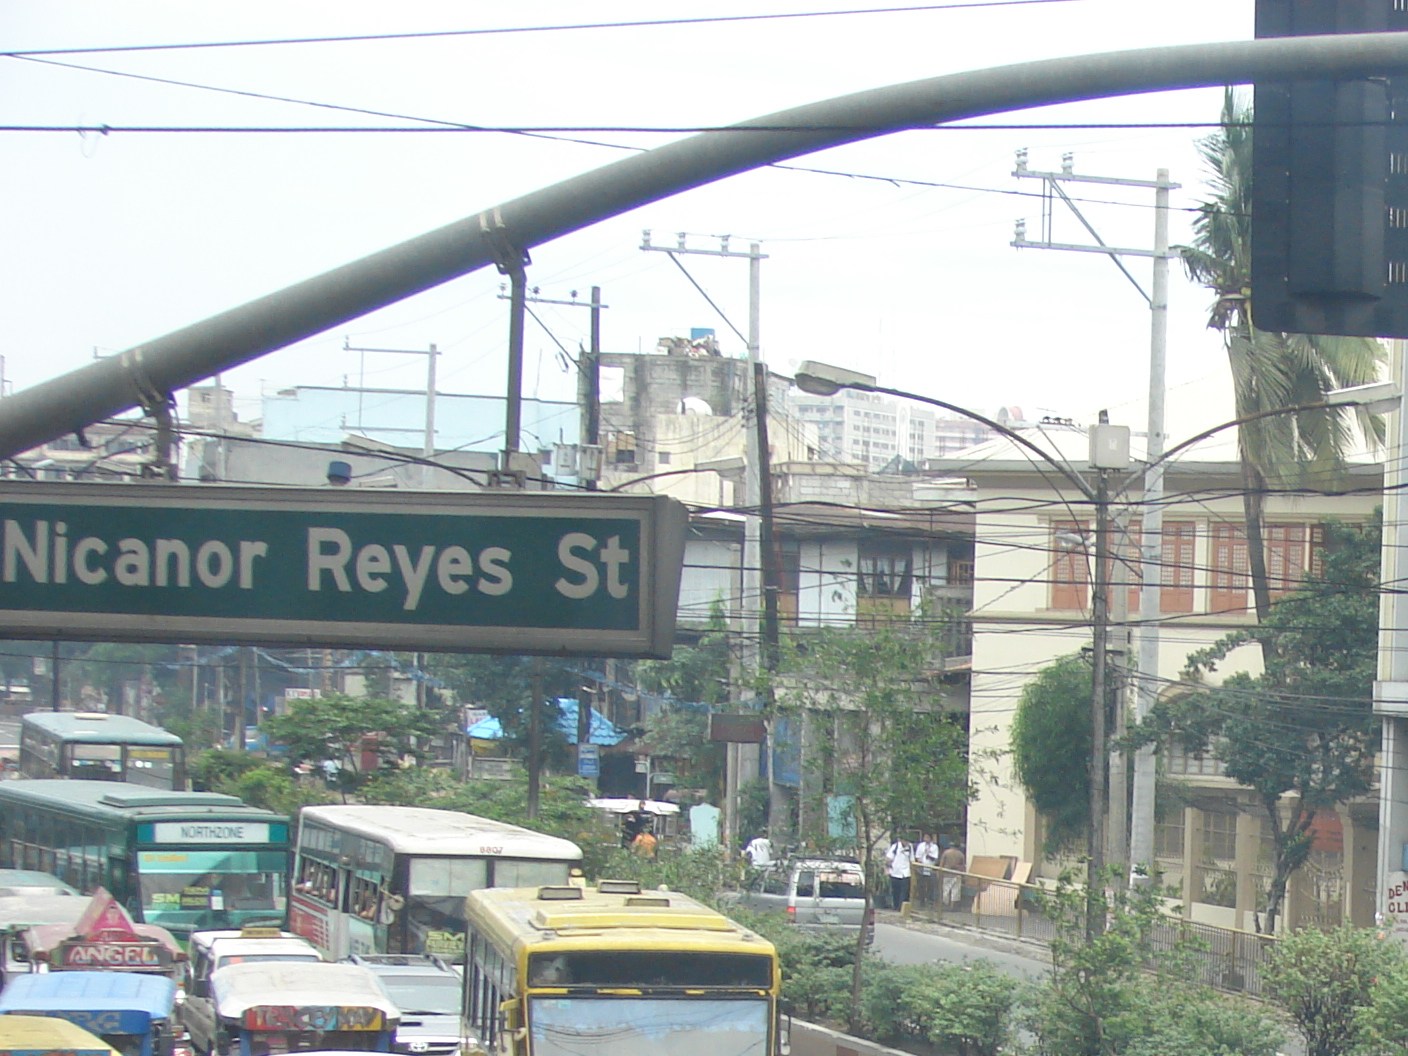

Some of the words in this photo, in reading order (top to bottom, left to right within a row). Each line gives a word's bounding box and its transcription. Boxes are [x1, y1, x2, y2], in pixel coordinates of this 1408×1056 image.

[2, 518, 267, 590] Nicanor
[306, 525, 513, 611] Reyes
[554, 531, 630, 601] St
[180, 826, 243, 840] NORTHZONE
[152, 893, 181, 904] SM
[67, 944, 158, 967] ANGEL
